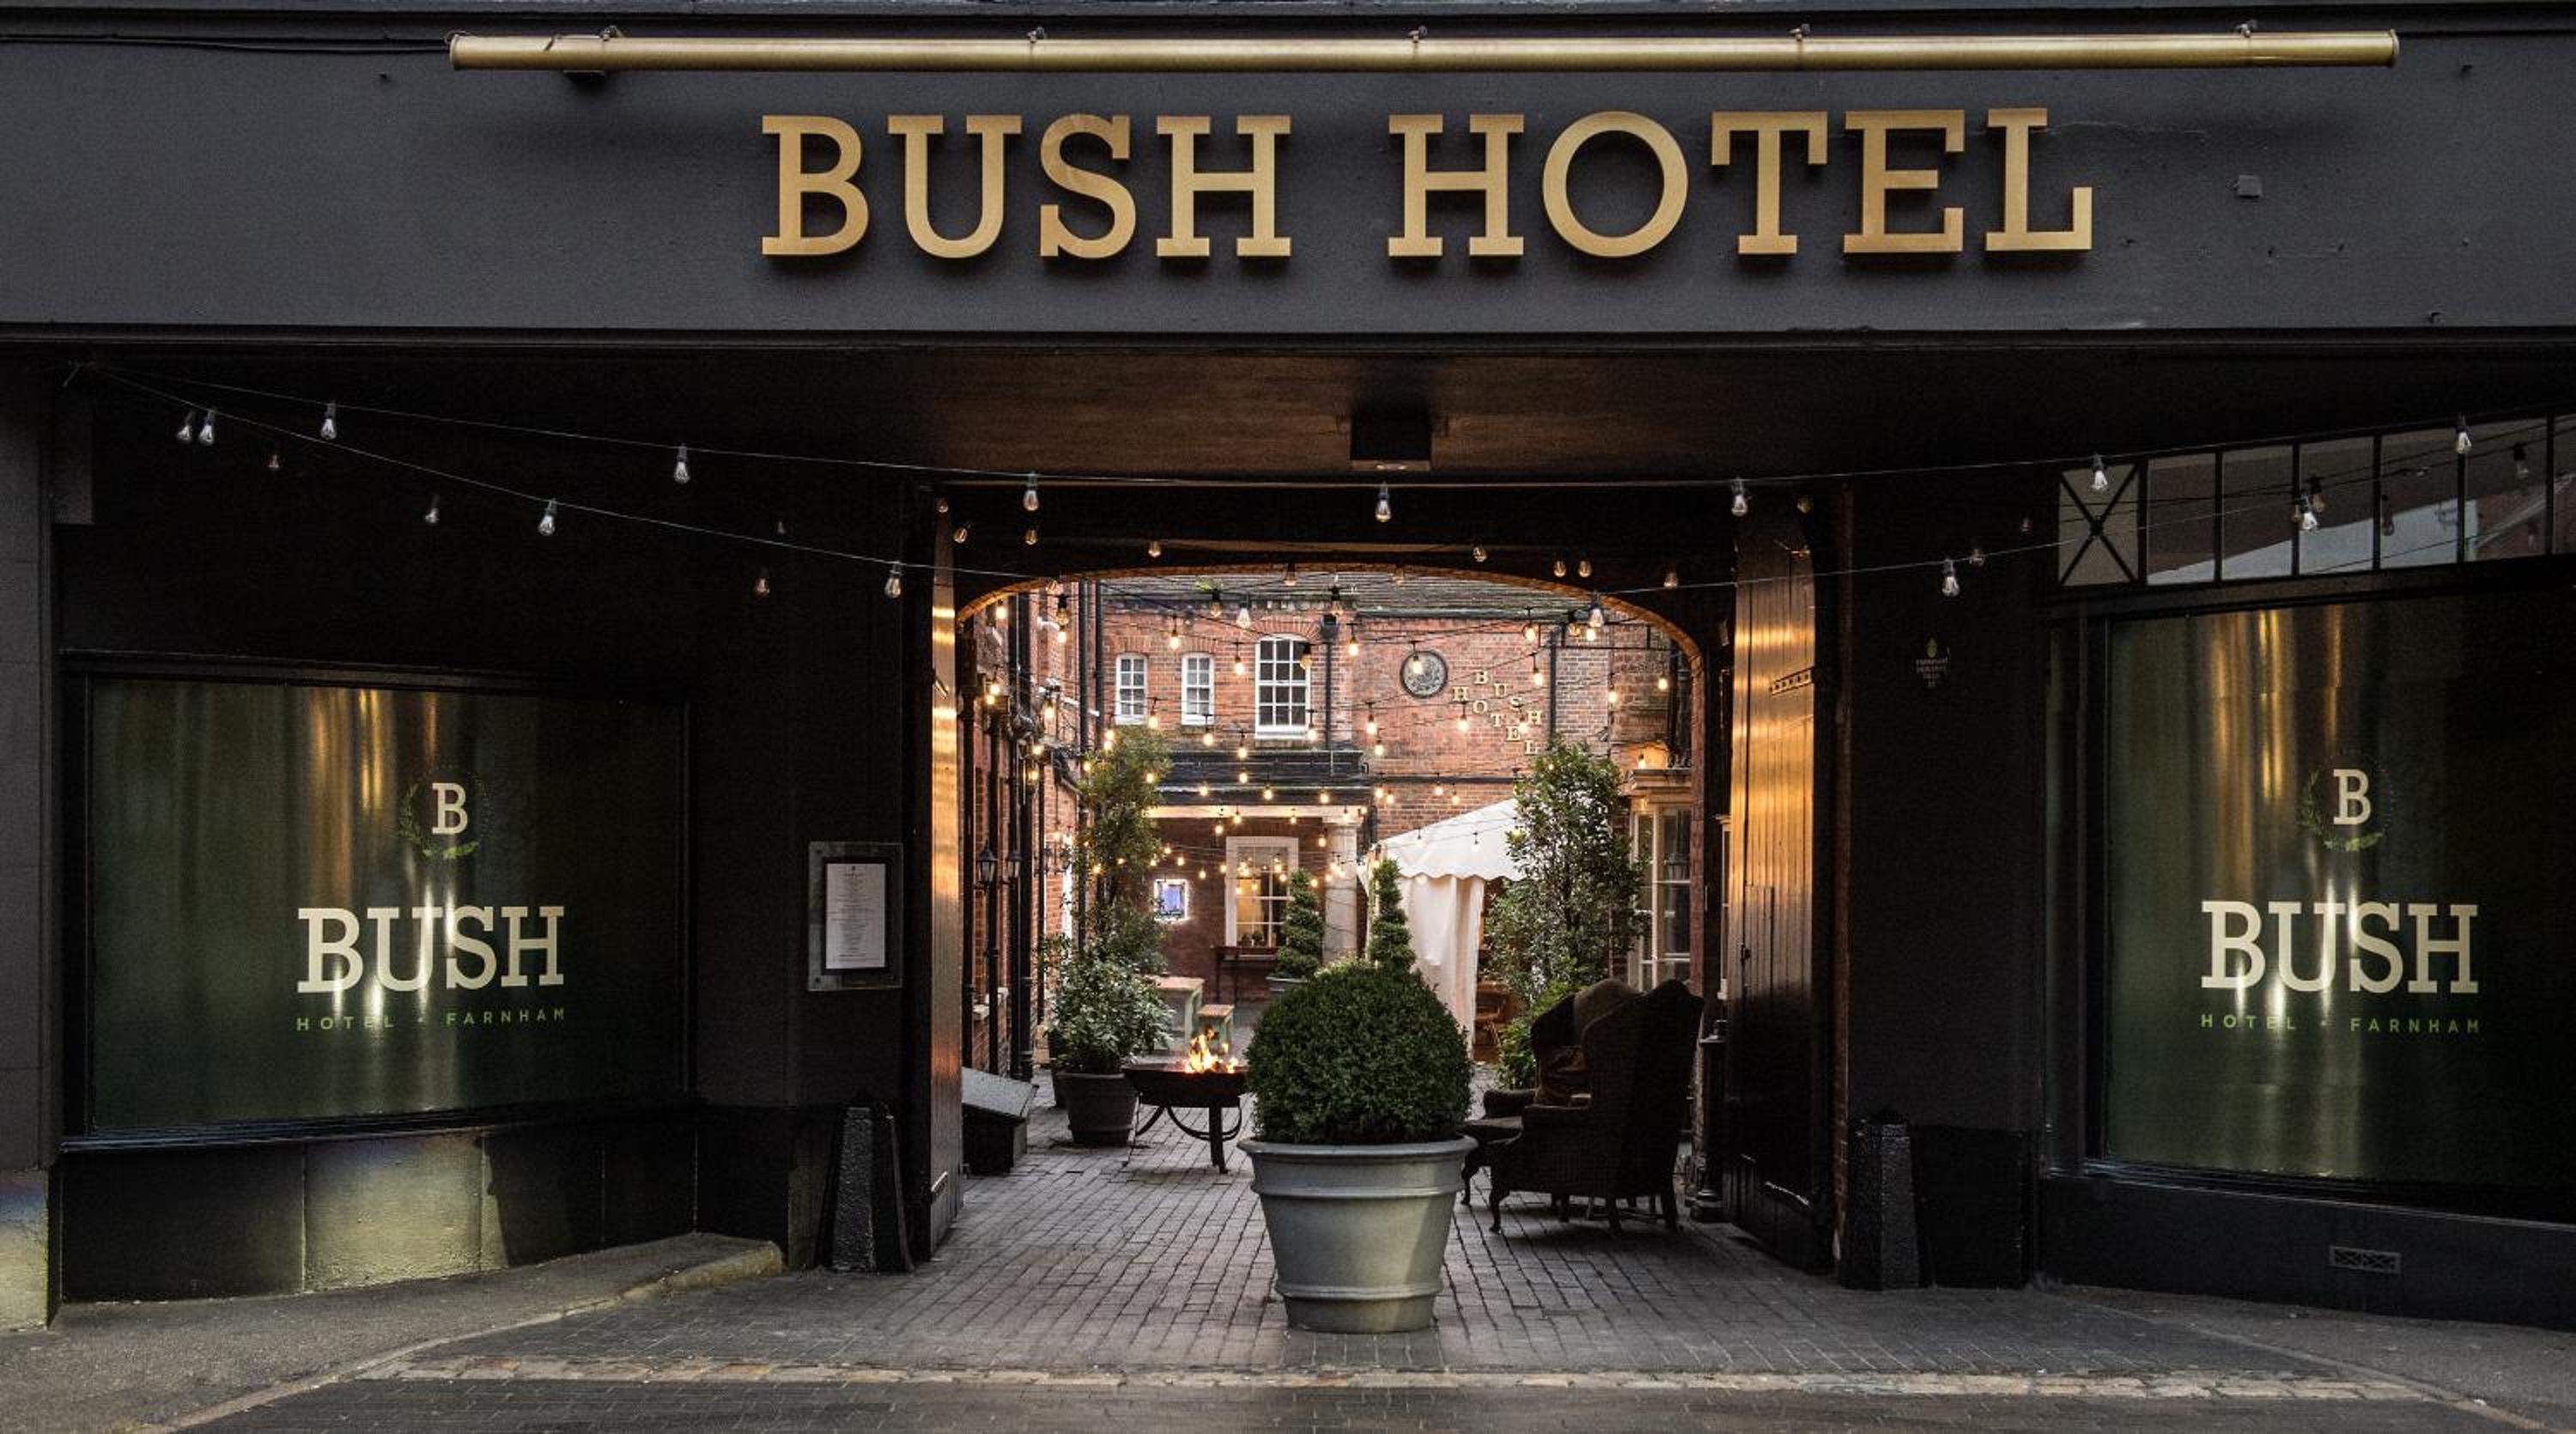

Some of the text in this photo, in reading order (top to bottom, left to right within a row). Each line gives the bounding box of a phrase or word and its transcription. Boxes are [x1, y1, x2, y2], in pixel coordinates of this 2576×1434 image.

[761, 107, 2093, 260] BUSH HOTEL
[1451, 686, 1540, 755] HOTEL
[1473, 671, 1542, 725] BUSH
[431, 782, 468, 835] B
[2333, 769, 2371, 824] B
[297, 905, 564, 993] BUSH
[2201, 900, 2478, 993] BUSH
[296, 1008, 565, 1031] HOTEL FARNHAM
[2201, 1014, 2479, 1033] HOTEL FARNHAM
